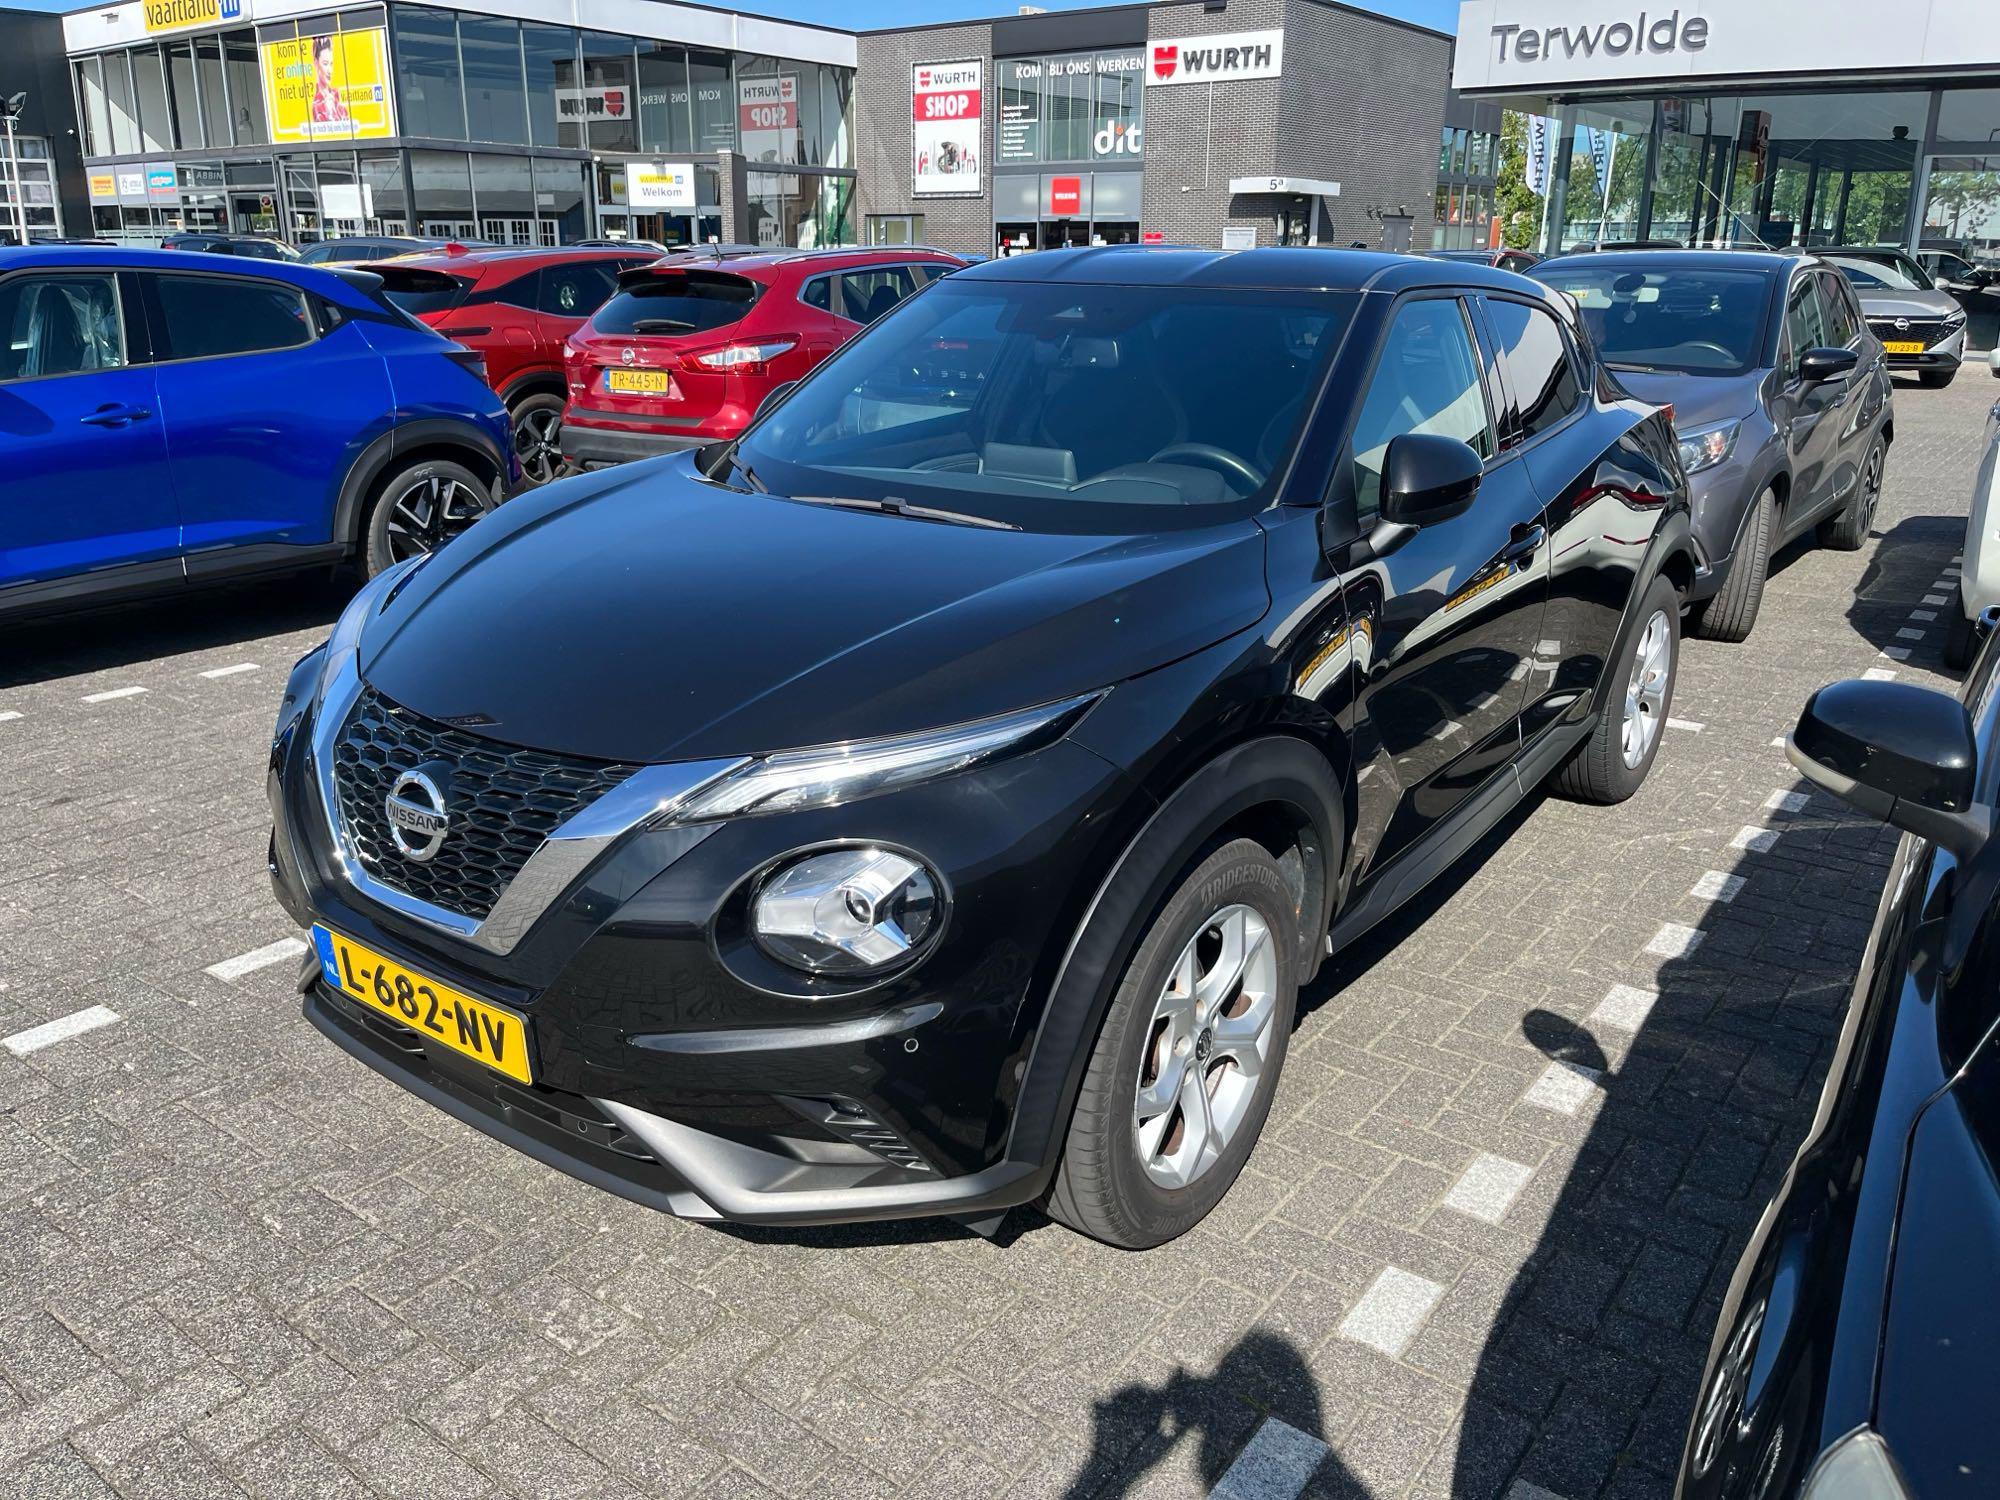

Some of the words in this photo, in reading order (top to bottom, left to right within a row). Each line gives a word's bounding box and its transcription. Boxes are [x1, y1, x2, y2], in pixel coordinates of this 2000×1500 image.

[1491, 9, 1708, 62] Terwolde
[276, 42, 297, 58] kom
[1183, 44, 1271, 72] WÜRTH
[934, 71, 976, 85] WÜRTH
[1015, 65, 1042, 79] KOM
[1049, 62, 1063, 76] BIJ
[1066, 60, 1090, 75] ONS
[1096, 58, 1145, 73] WERKEN
[279, 84, 298, 100] niet
[925, 94, 969, 118] SHOP
[1093, 119, 1142, 155] dit
[642, 187, 682, 197] Welkom
[612, 372, 663, 390] TR-445-N
[388, 803, 438, 831] NISSAN
[1201, 864, 1280, 911] BRIDGESTONE
[340, 945, 505, 1062] L-682-NV
